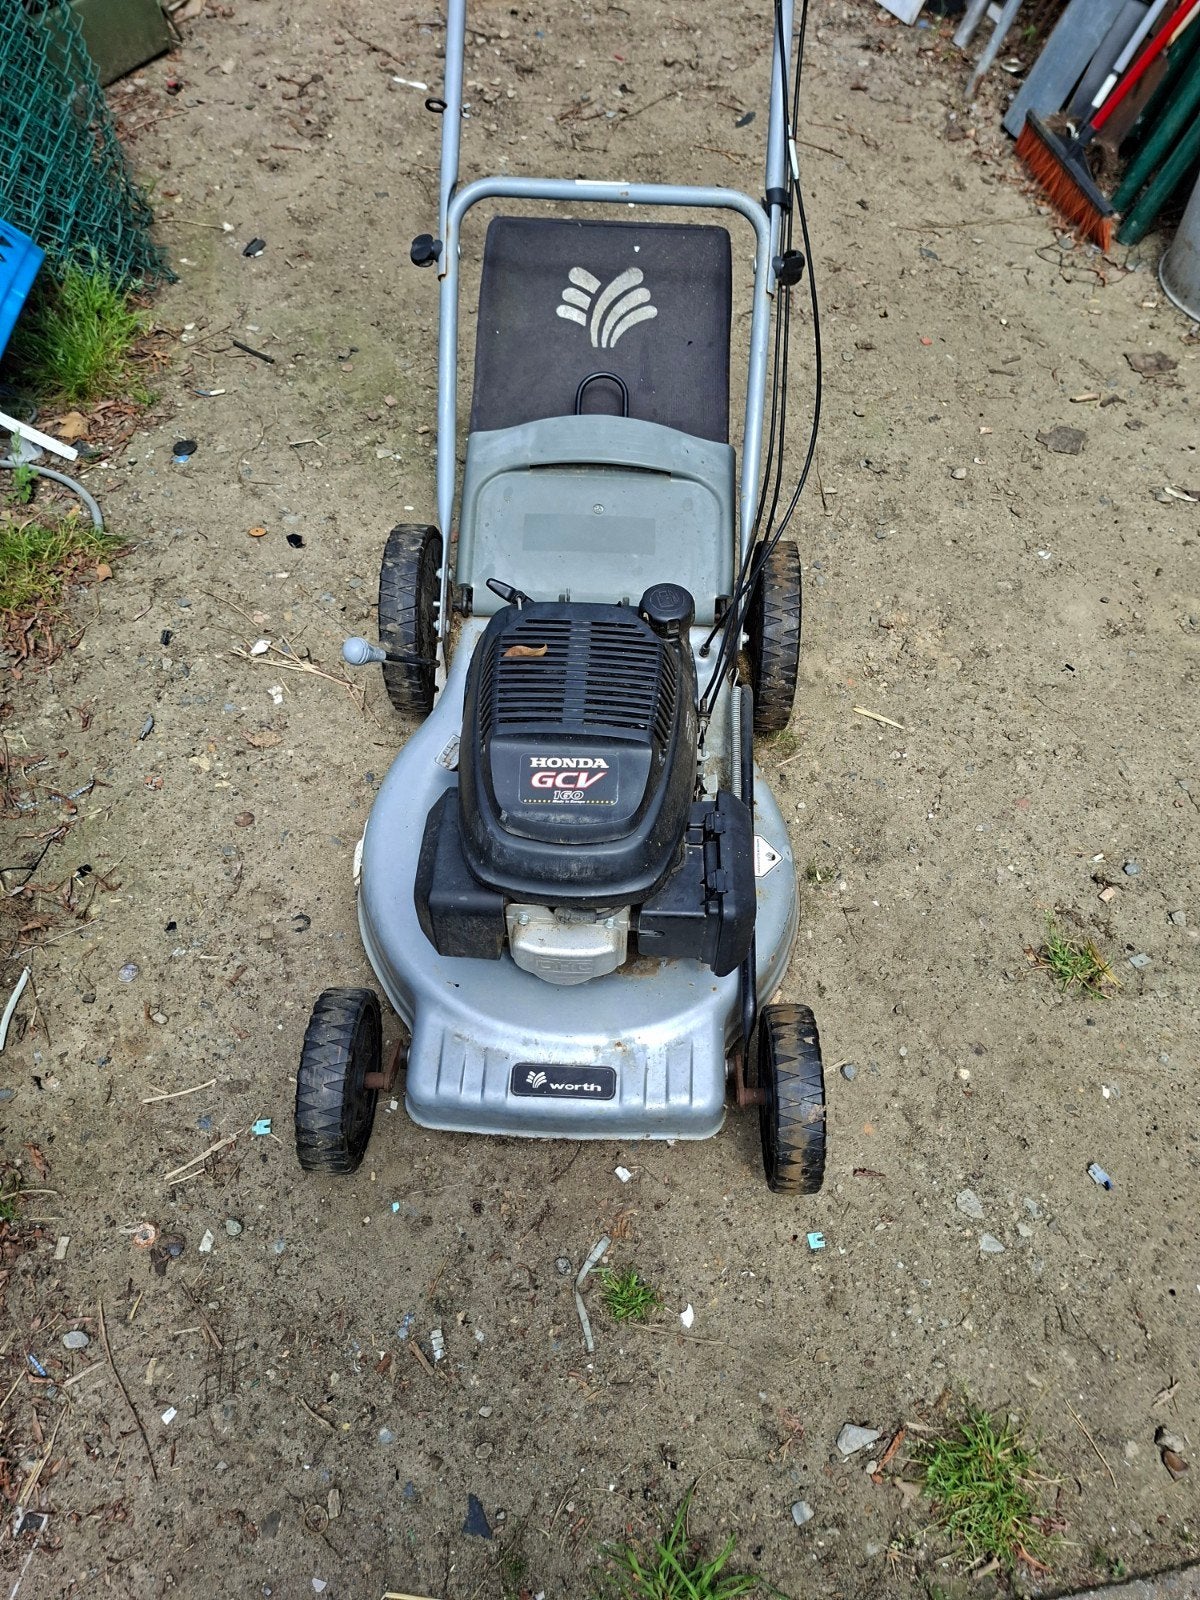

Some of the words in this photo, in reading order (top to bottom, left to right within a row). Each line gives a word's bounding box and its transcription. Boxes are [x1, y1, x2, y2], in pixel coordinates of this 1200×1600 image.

[529, 757, 610, 769] HONDA
[530, 770, 608, 790] GCV
[553, 790, 585, 800] 160
[549, 1082, 602, 1092] worth
